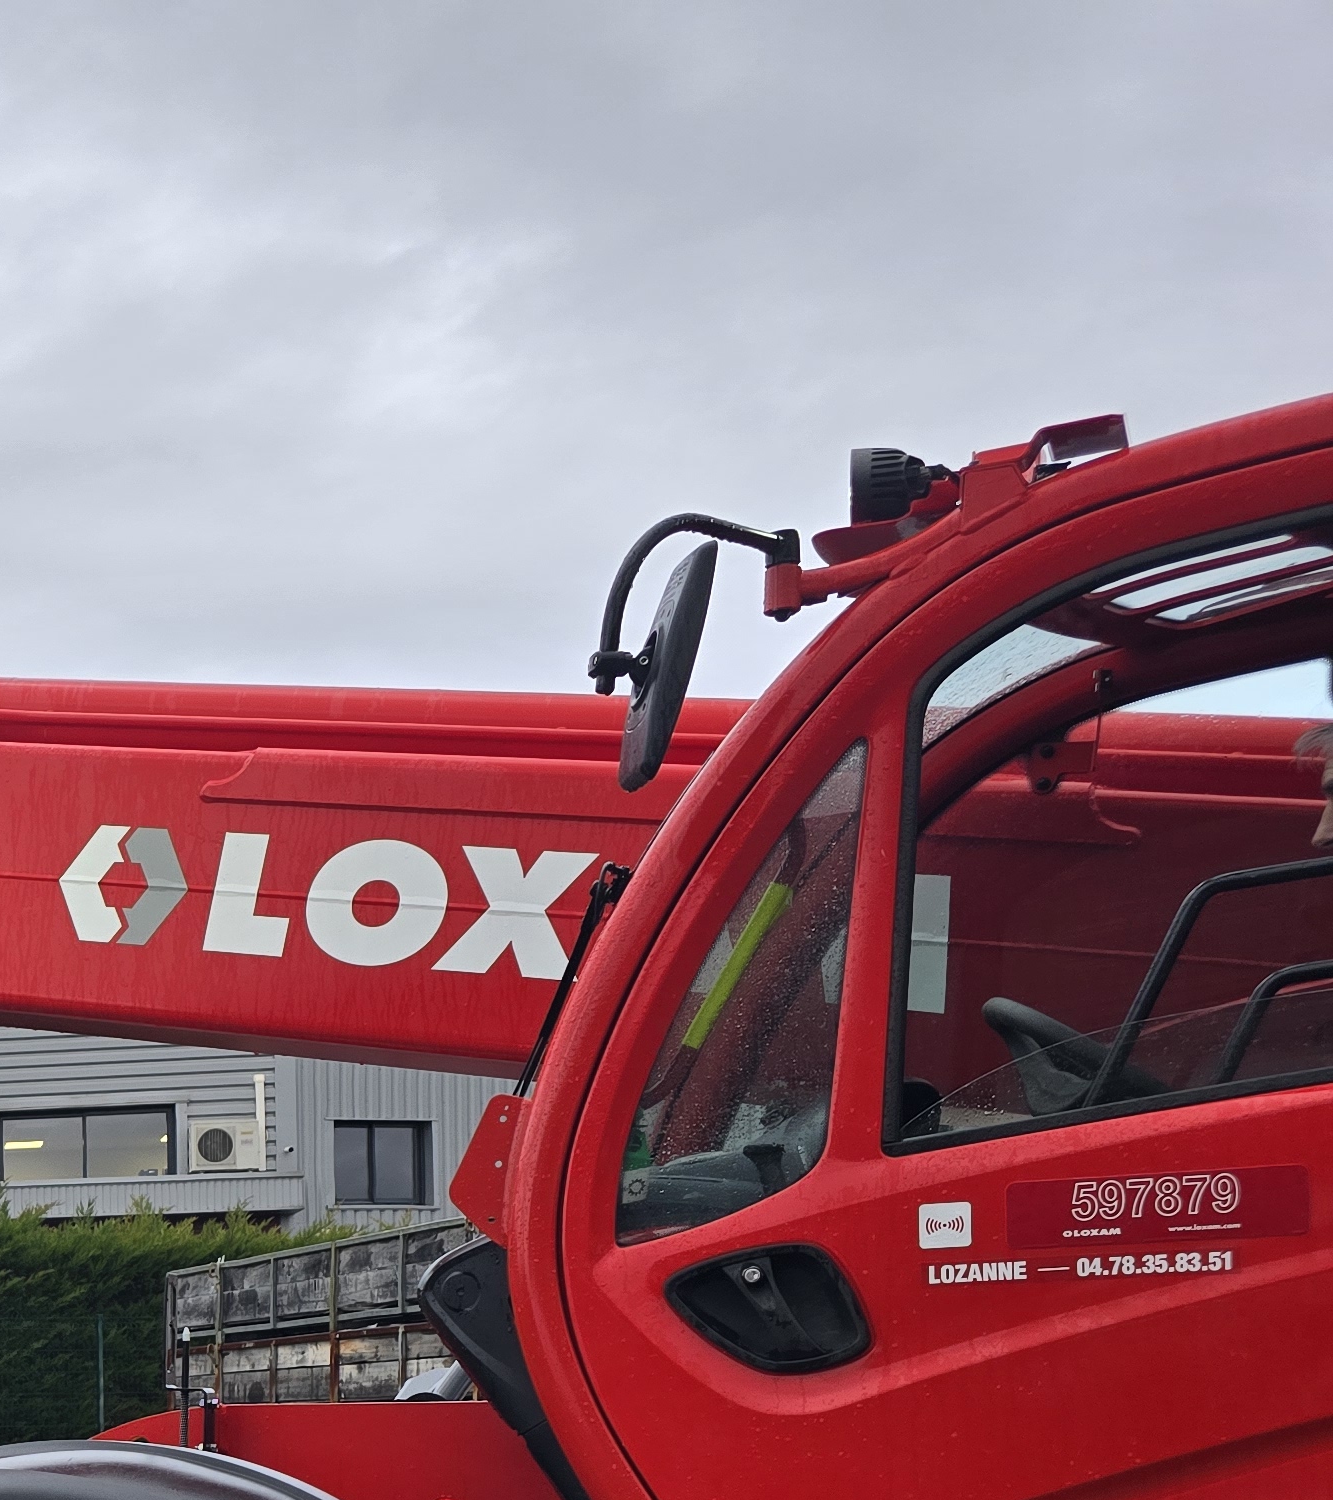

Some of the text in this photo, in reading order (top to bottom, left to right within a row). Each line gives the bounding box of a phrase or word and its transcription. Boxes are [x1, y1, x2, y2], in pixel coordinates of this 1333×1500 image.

[1071, 1172, 1241, 1221] 597879
[1073, 1227, 1121, 1238] LOXAM
[928, 1260, 1027, 1285] LOZANNE
[1076, 1251, 1233, 1277] 04.78.35.83.51
